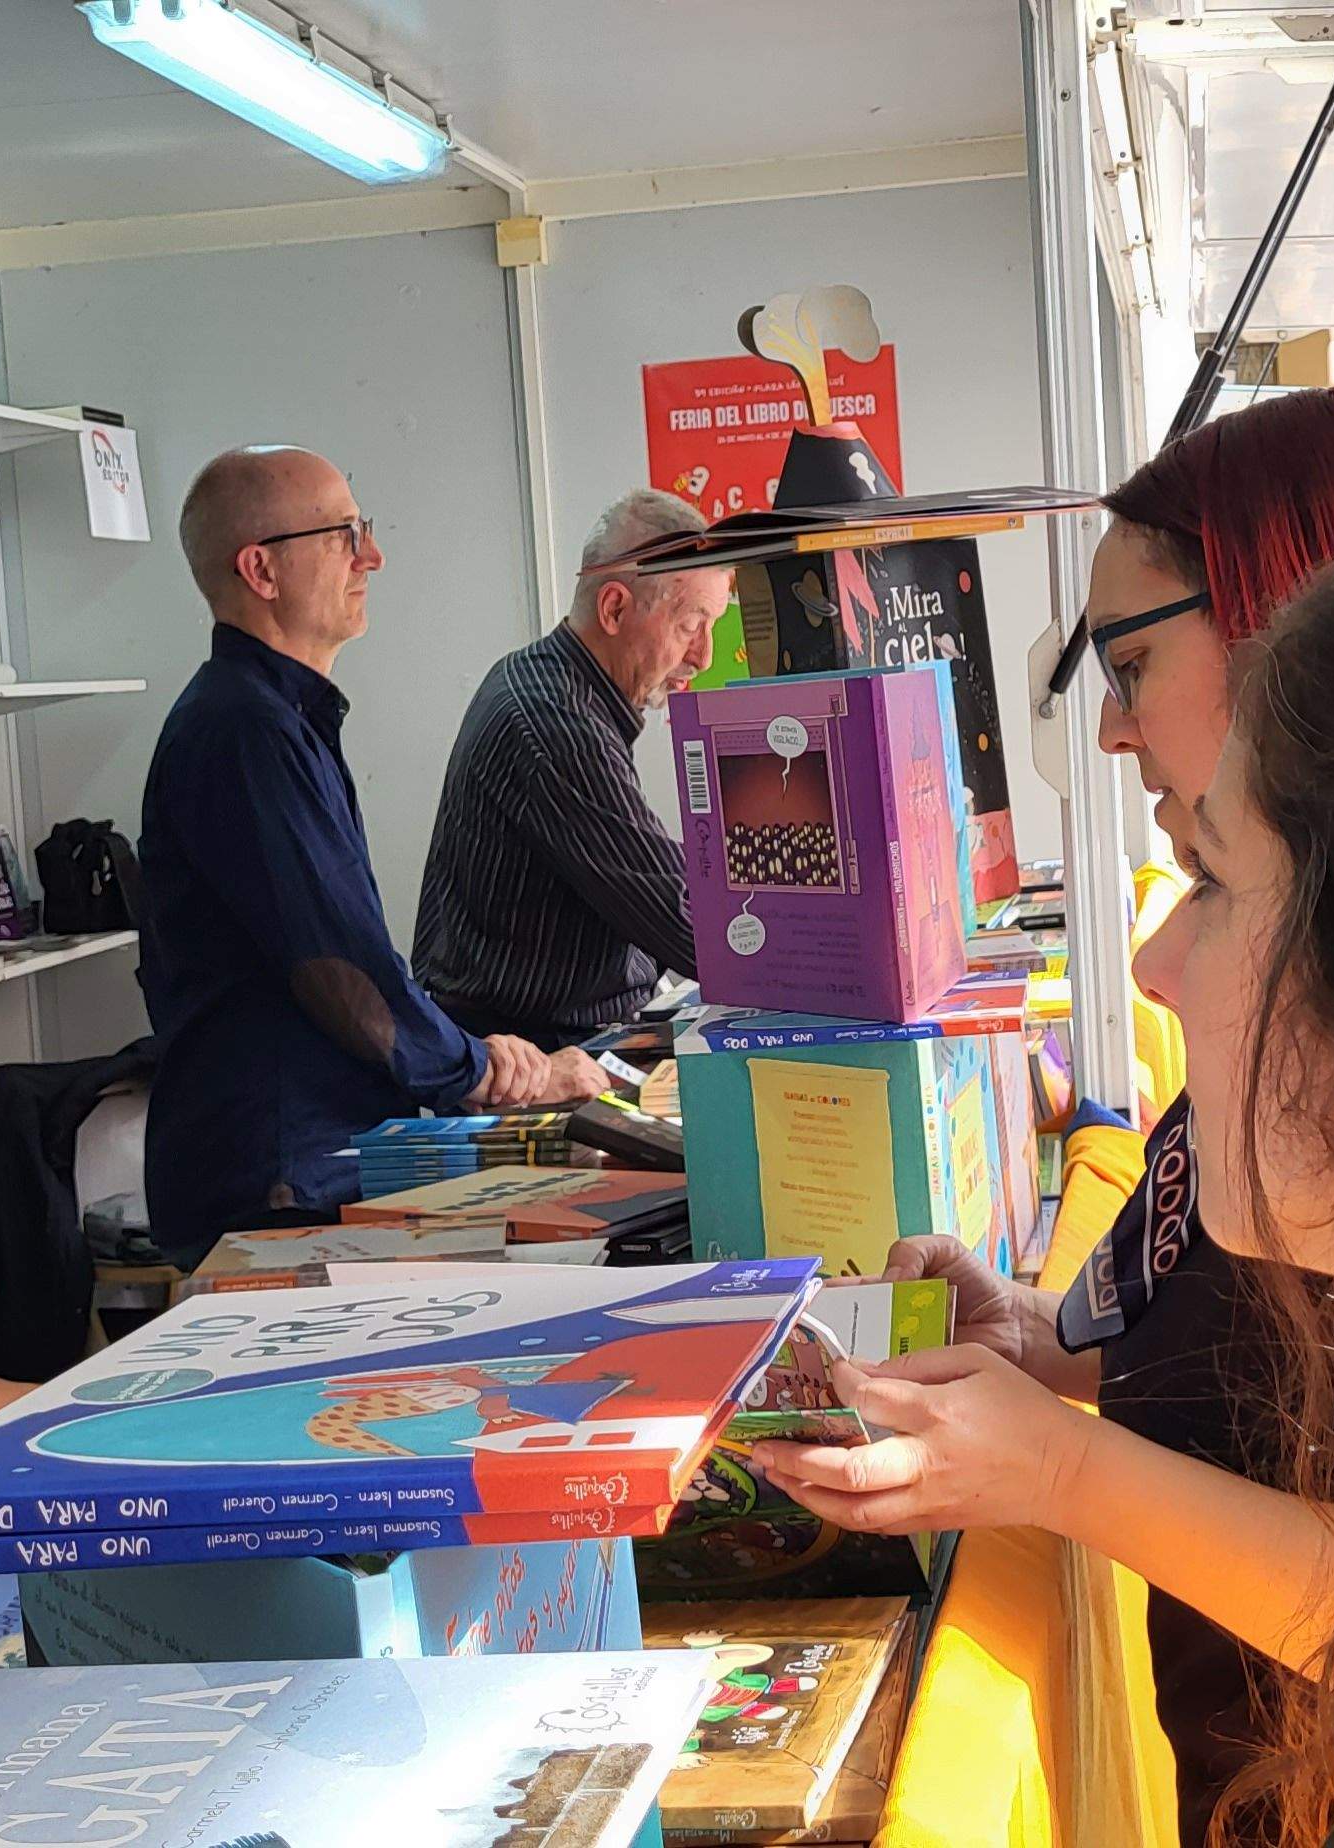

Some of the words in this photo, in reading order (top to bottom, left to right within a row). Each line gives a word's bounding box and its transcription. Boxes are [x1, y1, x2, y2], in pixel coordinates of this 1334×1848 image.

[669, 408, 713, 431] FERIA
[715, 405, 743, 426] DEL
[745, 401, 790, 425] LIBRO
[828, 394, 876, 417] UESCA
[884, 584, 945, 627] ¡Mira
[897, 622, 907, 633] AL
[722, 1036, 749, 1050] DOS
[757, 1034, 784, 1046] PARA
[791, 1032, 815, 1043] UNO
[366, 1291, 503, 1341] DOS
[230, 1296, 410, 1359] PARA
[118, 1314, 257, 1363] UNO
[397, 1488, 454, 1507] Susanna
[564, 1472, 629, 1505] Cosquillas
[119, 1497, 168, 1518] UNO
[223, 1496, 275, 1514] Queralt
[282, 1495, 338, 1511] Carmen
[359, 1492, 392, 1509] Isern
[37, 1499, 96, 1526] PARA
[551, 1507, 617, 1535] Cosquillas
[267, 1530, 323, 1546] Carmen
[344, 1525, 377, 1543] Isern
[383, 1520, 441, 1539] Susanna
[101, 1536, 150, 1556] UNO
[207, 1533, 260, 1550] Queralt
[17, 1540, 78, 1565] PARA
[534, 1667, 638, 1734] Cosquillas
[257, 1714, 311, 1751] Antonio
